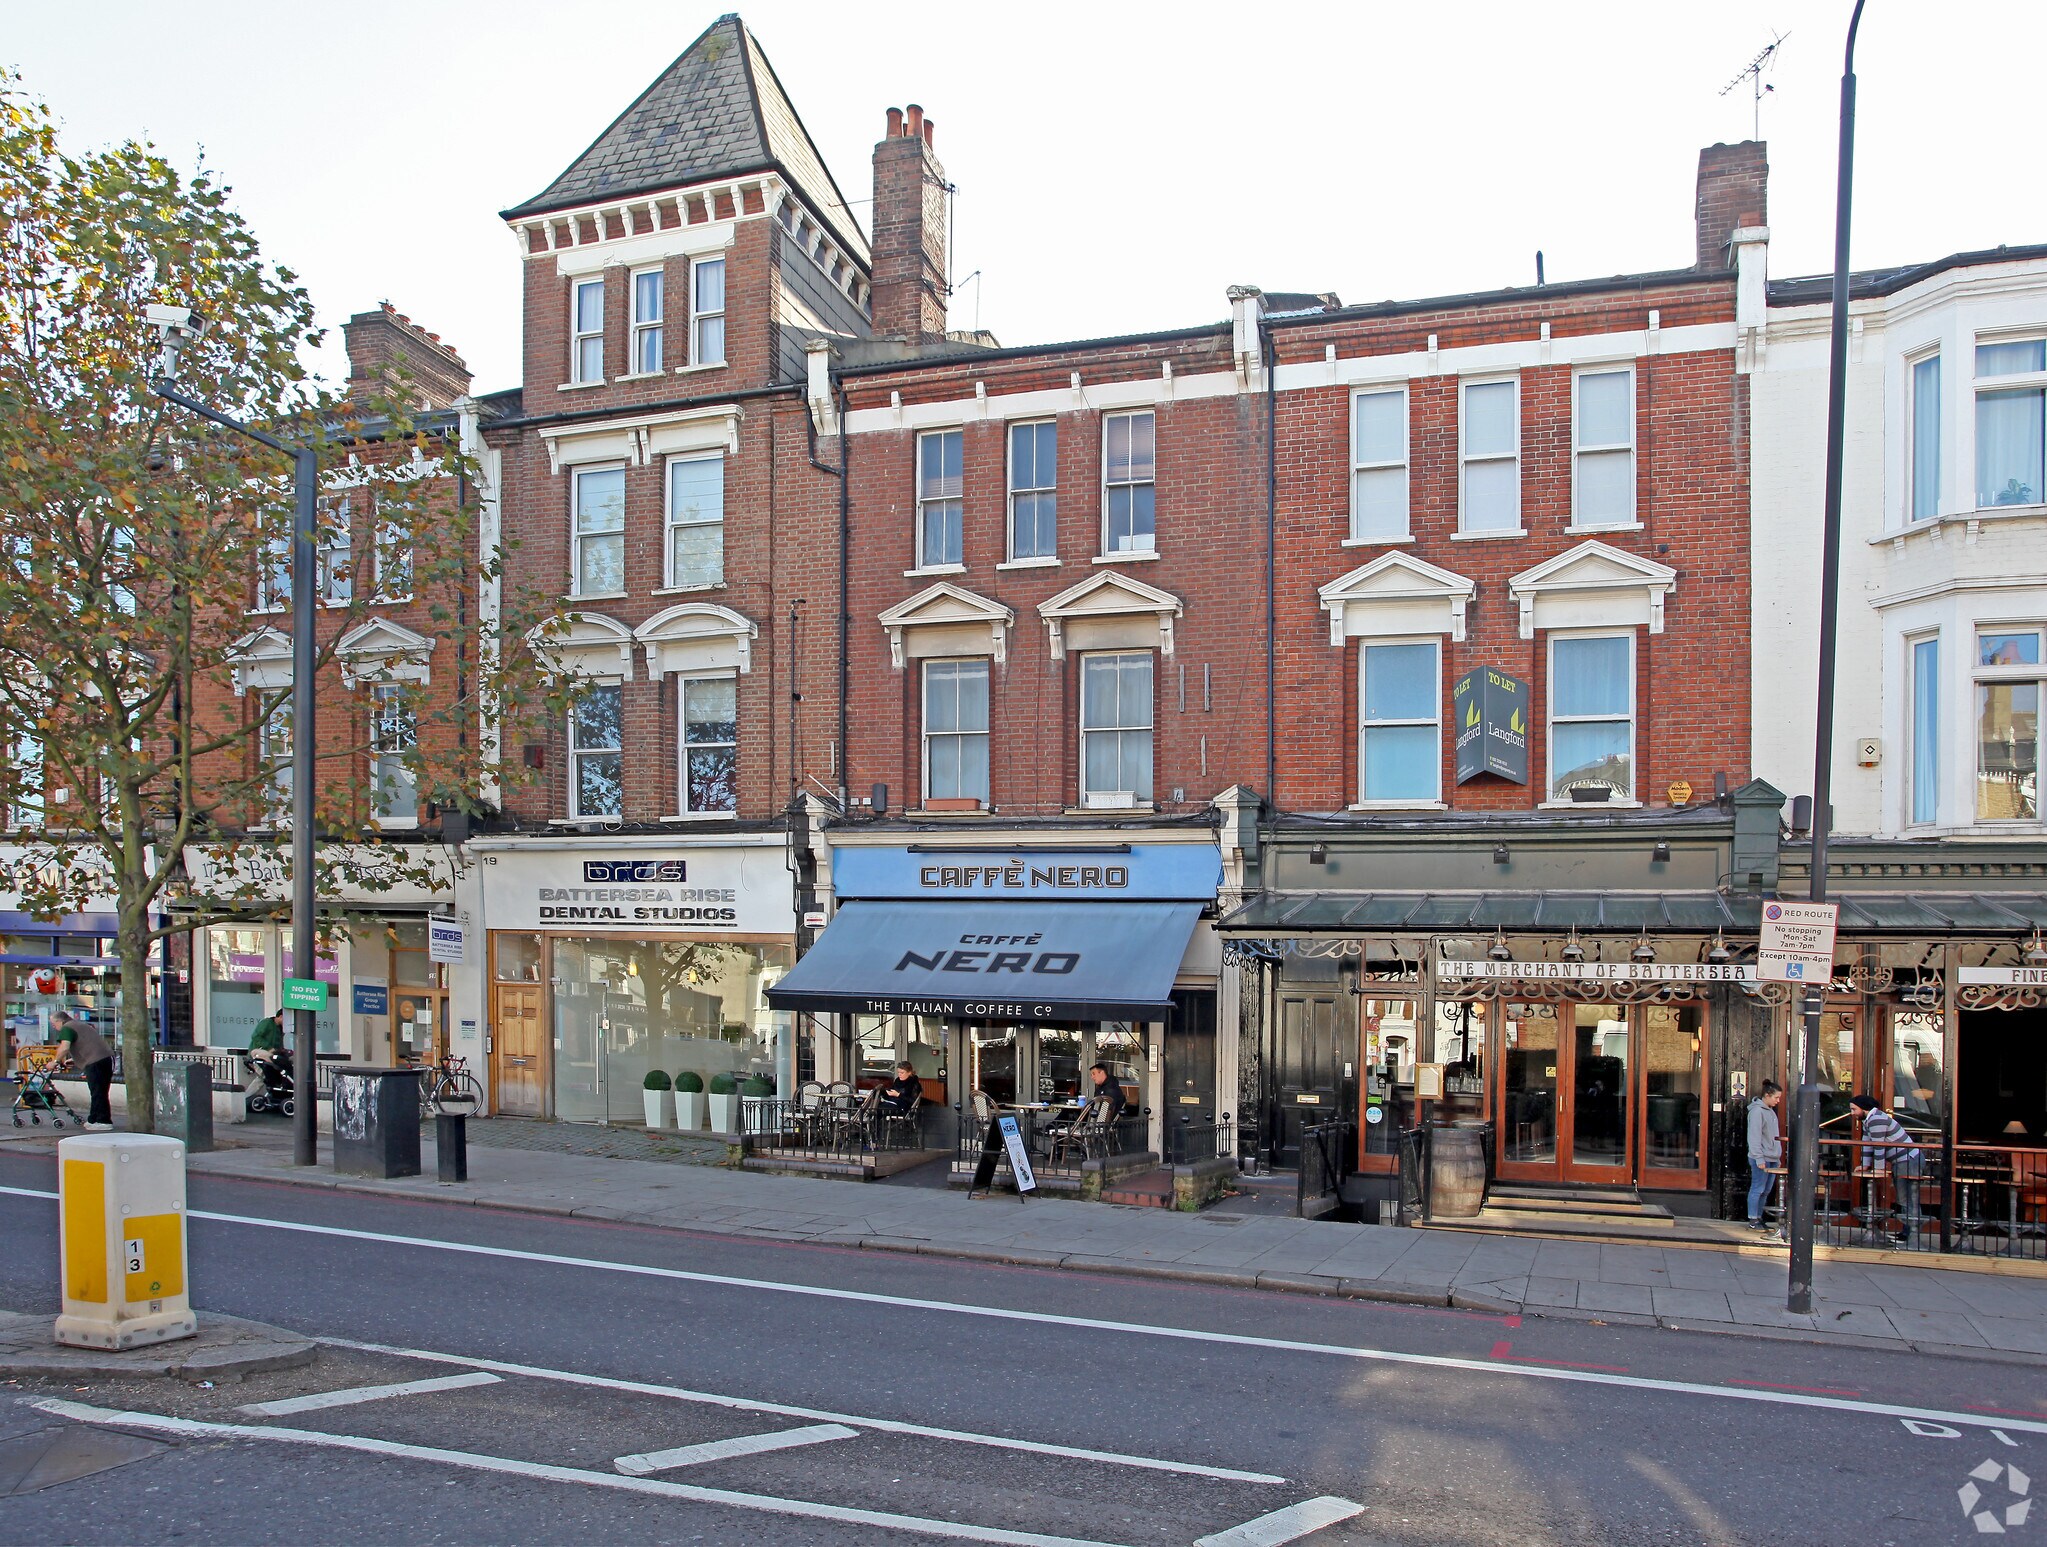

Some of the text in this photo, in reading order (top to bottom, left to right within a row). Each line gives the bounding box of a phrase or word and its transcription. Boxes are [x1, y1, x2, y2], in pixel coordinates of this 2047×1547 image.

[1453, 678, 1471, 700] TO LET
[1488, 671, 1516, 693] TO LET
[1488, 721, 1525, 748] Langford
[483, 857, 497, 865] 19
[587, 863, 681, 881] brds
[920, 857, 1128, 888] CAFFÈ NERO
[539, 888, 736, 902] BATTERSEA RISE
[539, 906, 736, 920] DENTAL STUDIOS
[1788, 926, 1822, 935] stopping
[959, 933, 1043, 945] CAFFÈ
[1780, 941, 1815, 949] 7am-7pm
[1783, 934, 1816, 942] Mon-Sat
[894, 950, 1080, 974] NERO
[1760, 952, 1830, 962] Except 10am-4pm
[1441, 962, 1746, 980] THE MERCHANT OF BATTERSEA
[290, 993, 320, 1001] TIPPING
[866, 1001, 890, 1012] THE
[901, 1002, 954, 1014] ITALIAN
[964, 1004, 1022, 1016] COFFEE
[131, 1241, 138, 1252] 1
[130, 1258, 140, 1272] 3
